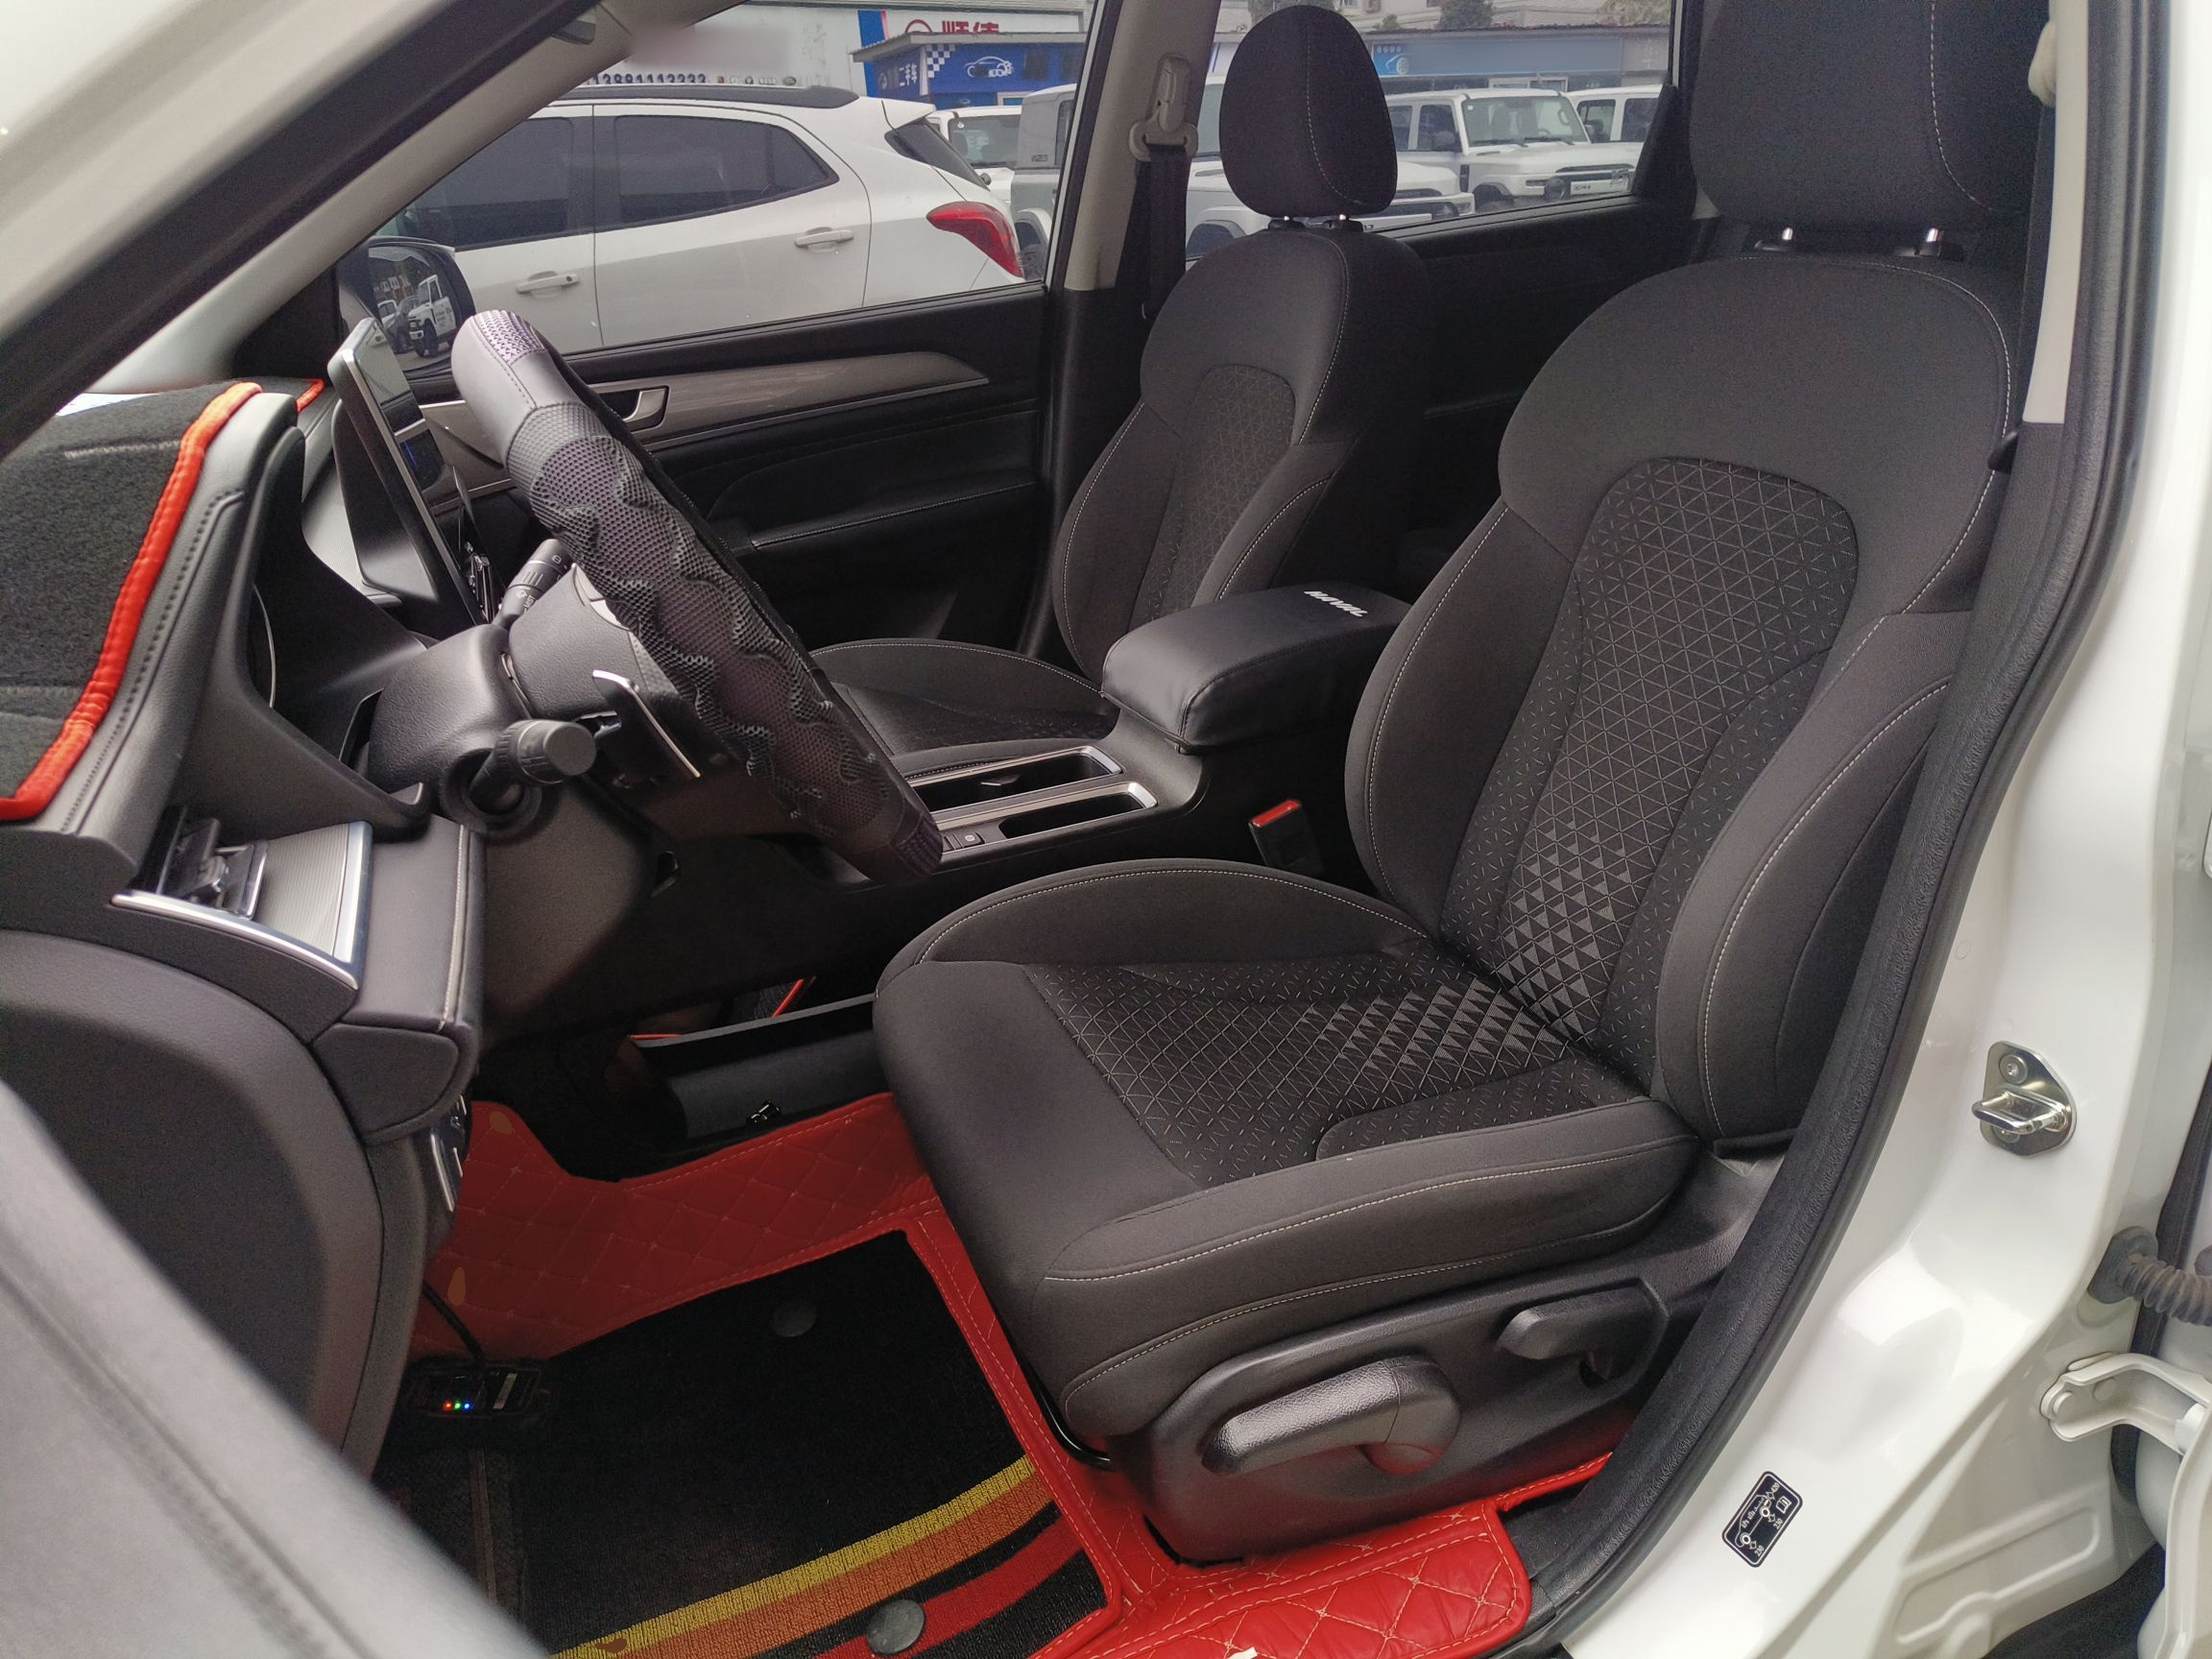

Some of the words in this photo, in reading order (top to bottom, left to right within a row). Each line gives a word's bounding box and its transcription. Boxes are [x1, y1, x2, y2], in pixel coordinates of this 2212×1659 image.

[899, 63, 917, 86] 二手车
[1774, 1518, 1783, 1530] 230
[1755, 1545, 1764, 1557] 230
